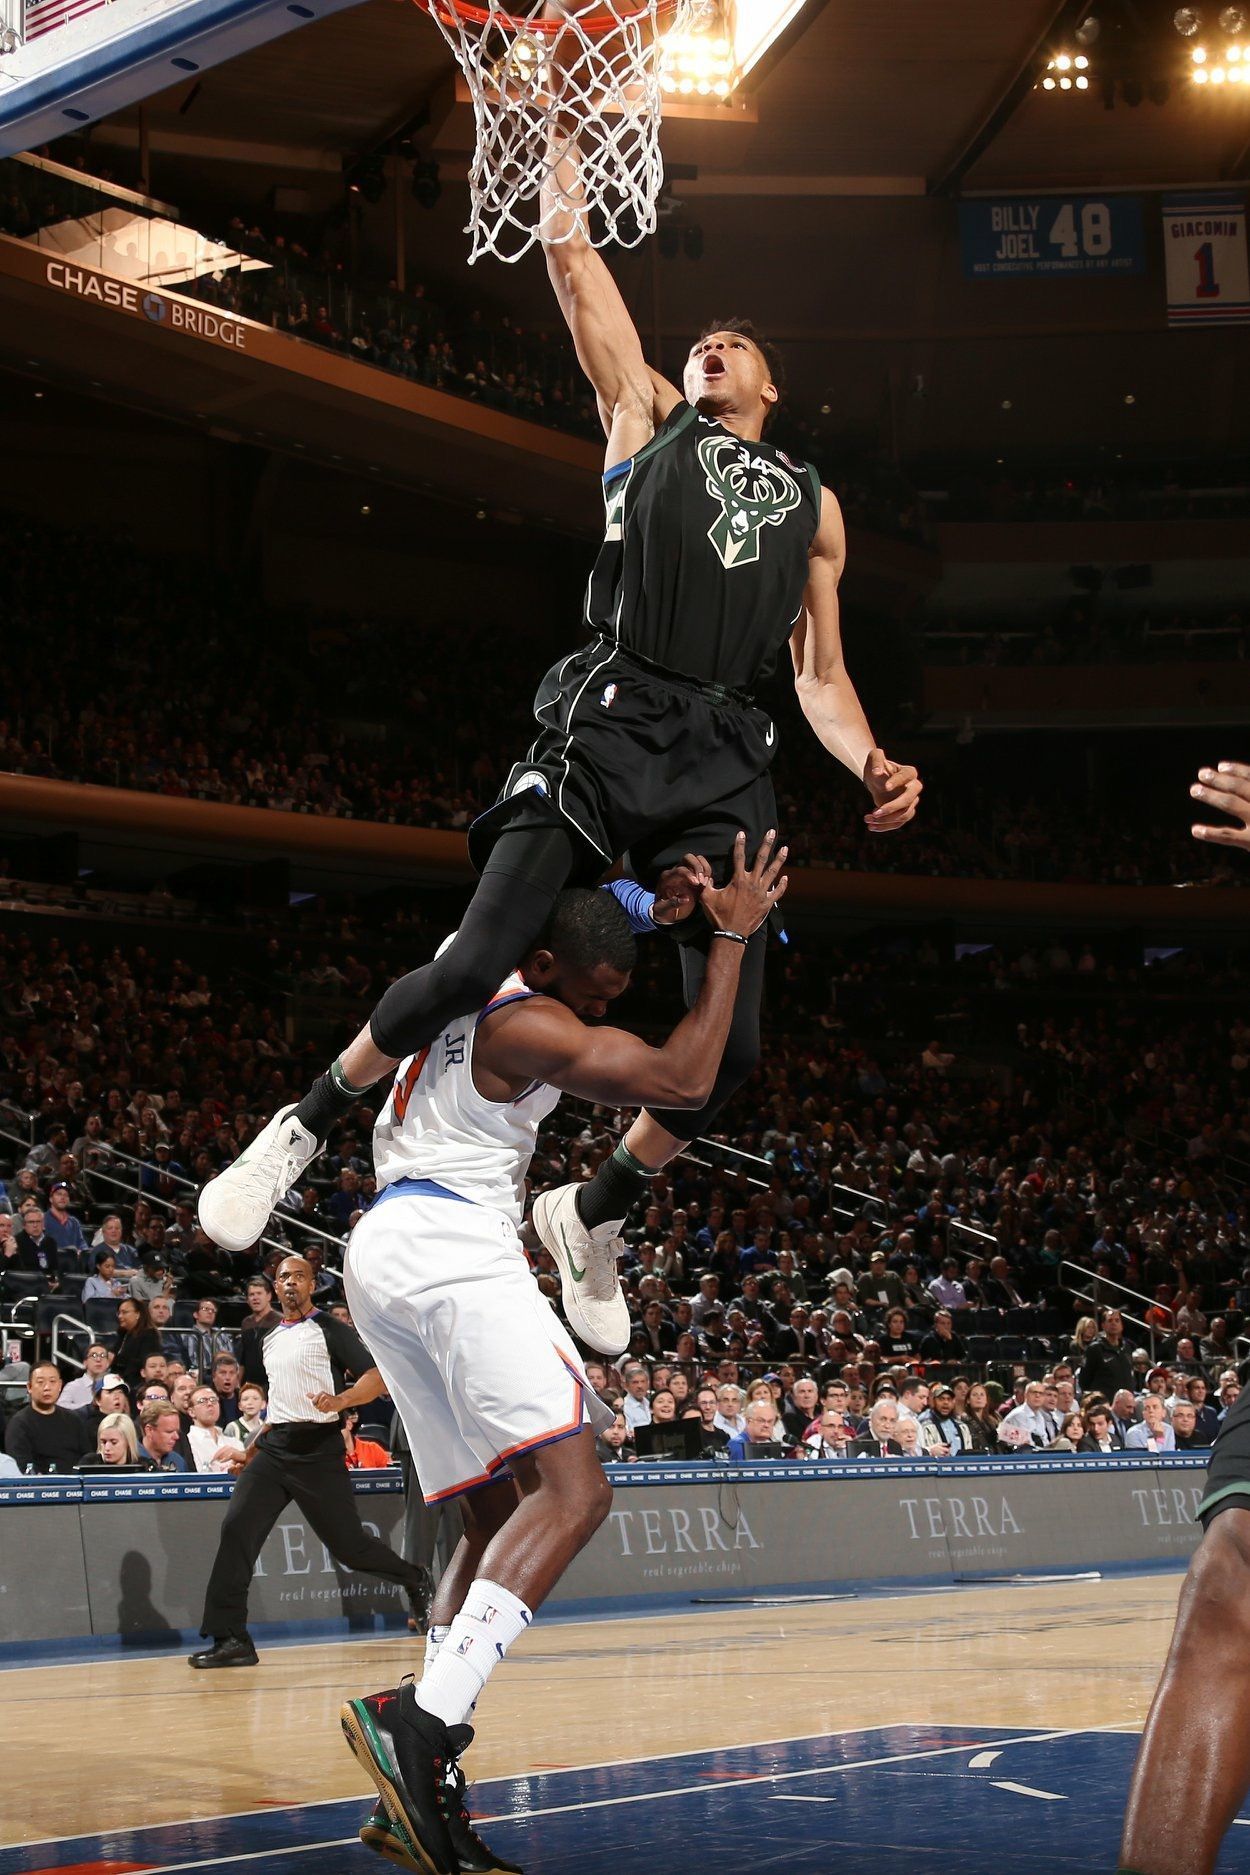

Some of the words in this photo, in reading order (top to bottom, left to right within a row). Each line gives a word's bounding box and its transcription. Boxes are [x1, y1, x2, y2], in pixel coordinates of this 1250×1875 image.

[991, 205, 1041, 232] BILLY
[1048, 202, 1112, 258] 48
[1170, 221, 1238, 239] GIACOMIN
[995, 233, 1040, 260] JOEL
[1193, 242, 1221, 298] 1
[46, 262, 138, 313] CHASE
[171, 303, 246, 349] BRIDGE
[609, 1507, 760, 1556] TERRA
[899, 1496, 1022, 1539] TERRA
[643, 1564, 664, 1577] real
[667, 1561, 713, 1578] vegetable
[716, 1560, 741, 1576] chips
[280, 1587, 305, 1601] real
[310, 1584, 368, 1602] vegetable
